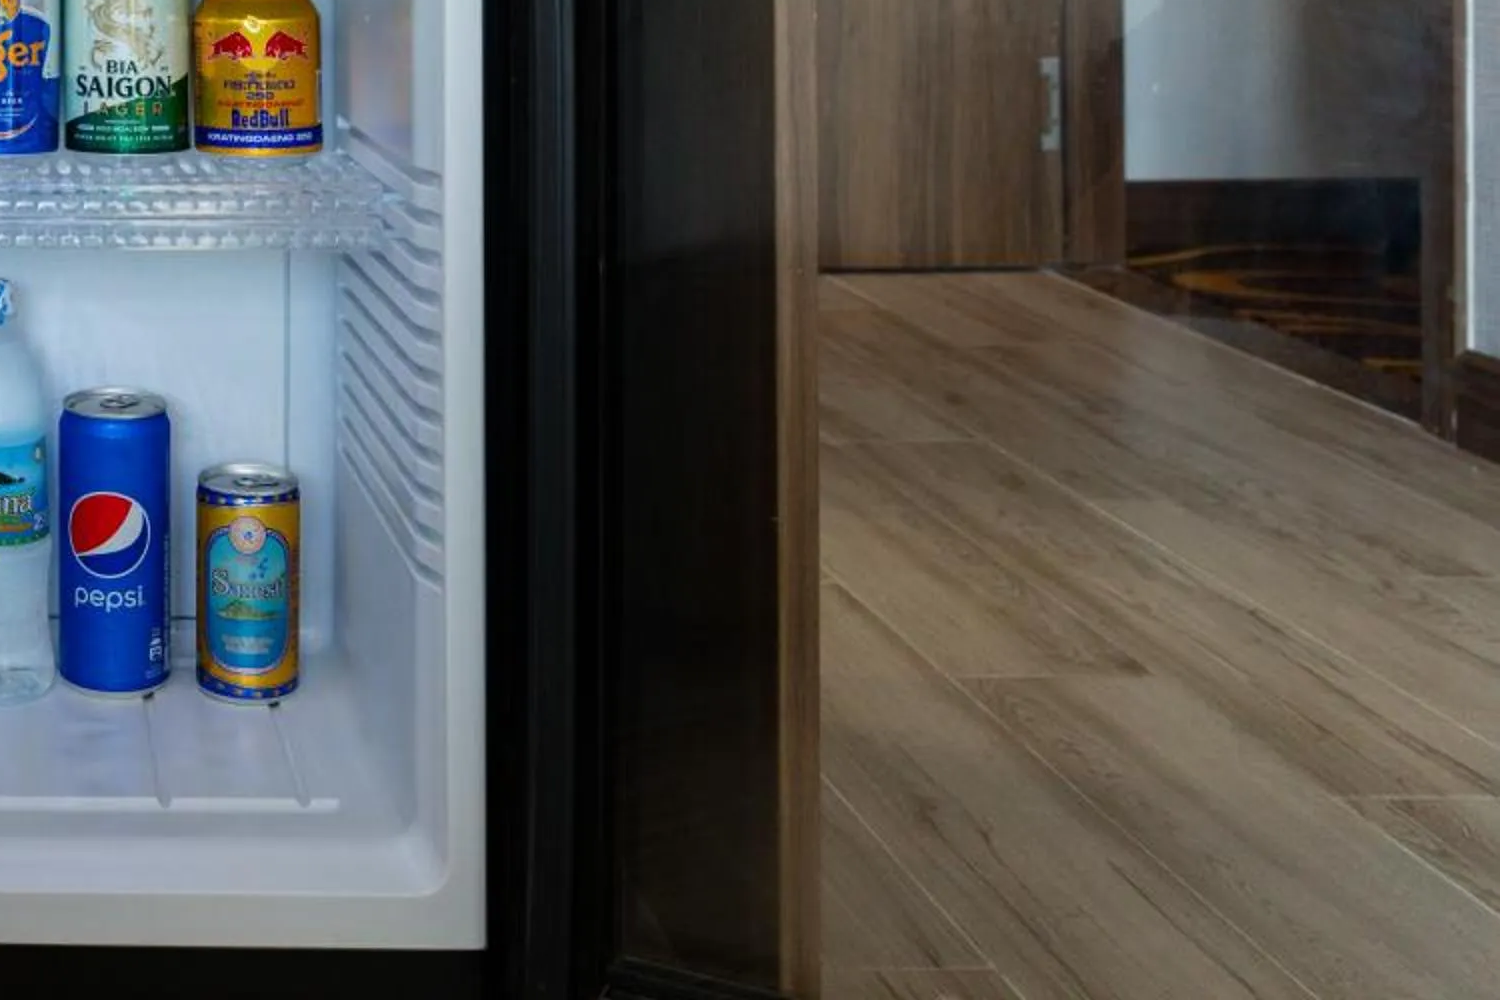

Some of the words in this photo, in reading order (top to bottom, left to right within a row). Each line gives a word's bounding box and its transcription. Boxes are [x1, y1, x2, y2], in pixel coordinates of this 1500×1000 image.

[106, 59, 138, 75] BIA
[75, 73, 173, 99] SAIGON
[83, 100, 163, 116] LAGER
[74, 585, 144, 613] pepsi
